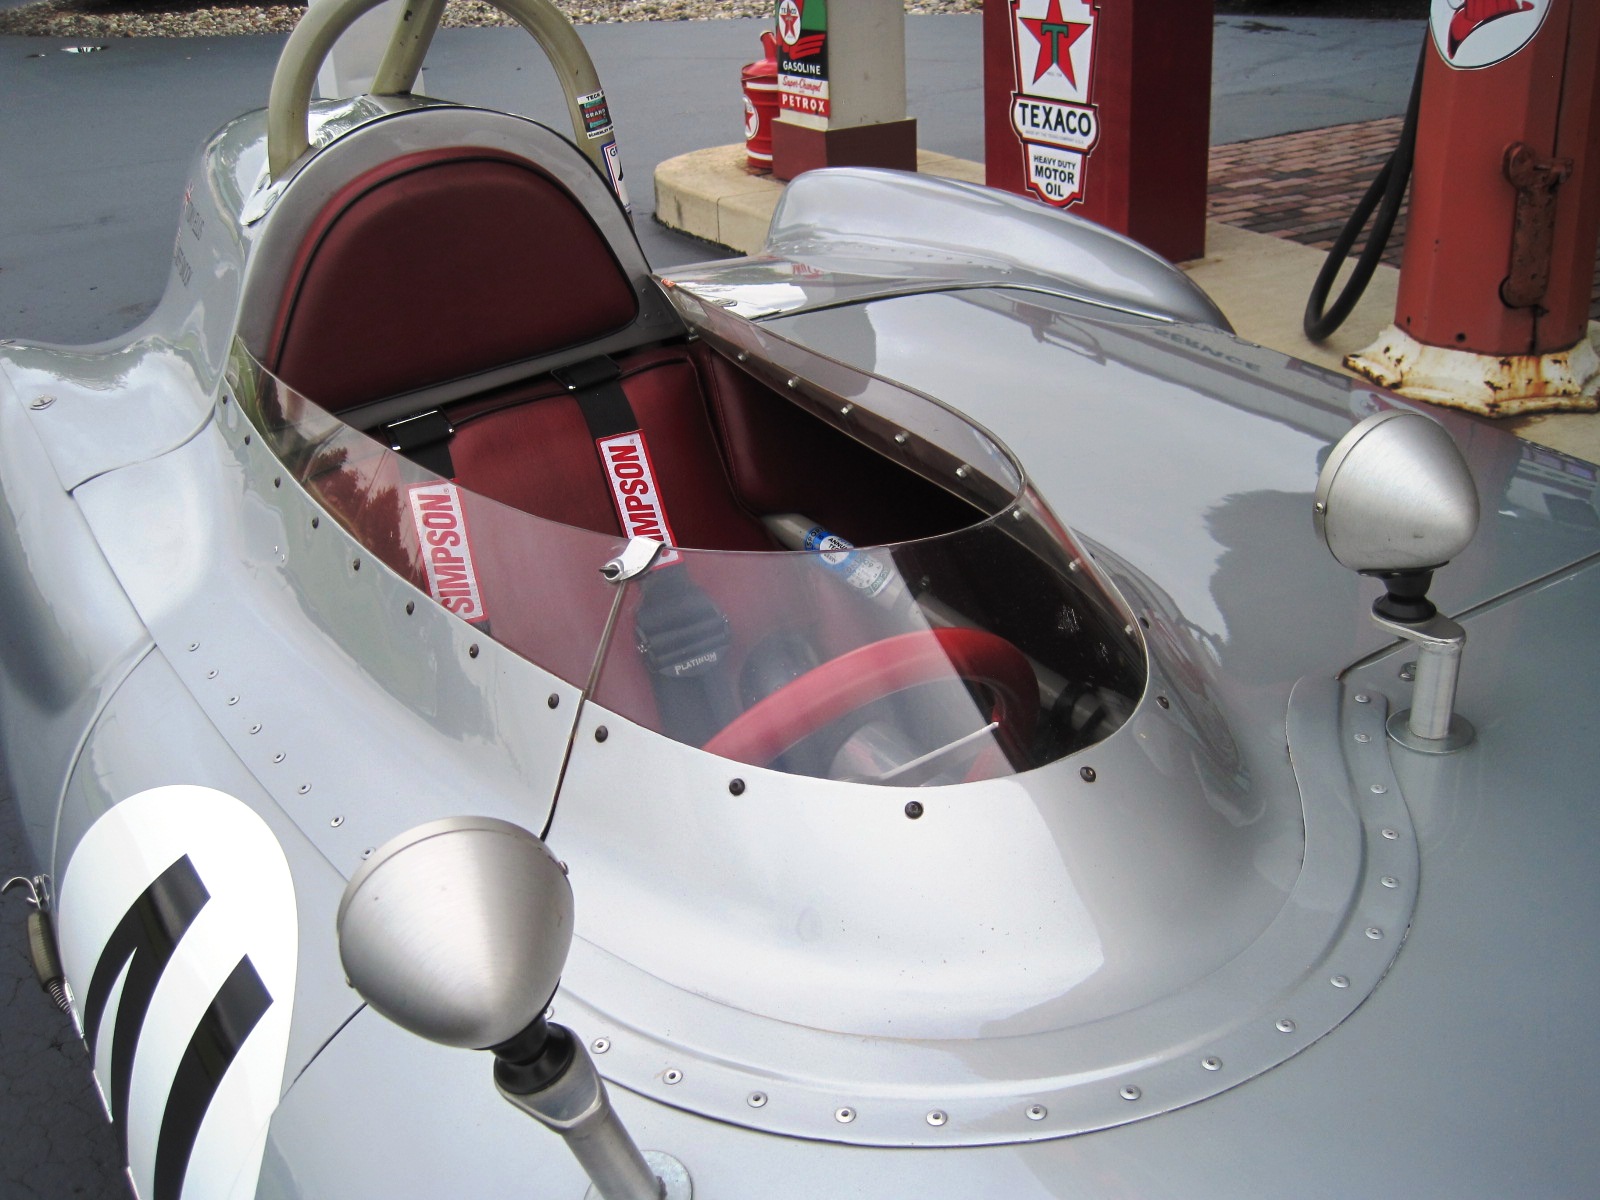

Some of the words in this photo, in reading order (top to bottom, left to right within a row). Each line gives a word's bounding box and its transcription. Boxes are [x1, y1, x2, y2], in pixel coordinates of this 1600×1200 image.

[783, 61, 821, 75] GASOLINE
[782, 94, 825, 112] PETROX
[1019, 103, 1091, 137] TEXACO
[1033, 155, 1057, 166] HEAVY
[1057, 160, 1076, 170] DUTY
[1035, 165, 1075, 185] MOTOR
[1045, 182, 1064, 197] OIL
[417, 494, 475, 614] SIMPSON
[674, 651, 717, 676] PLATINUM
